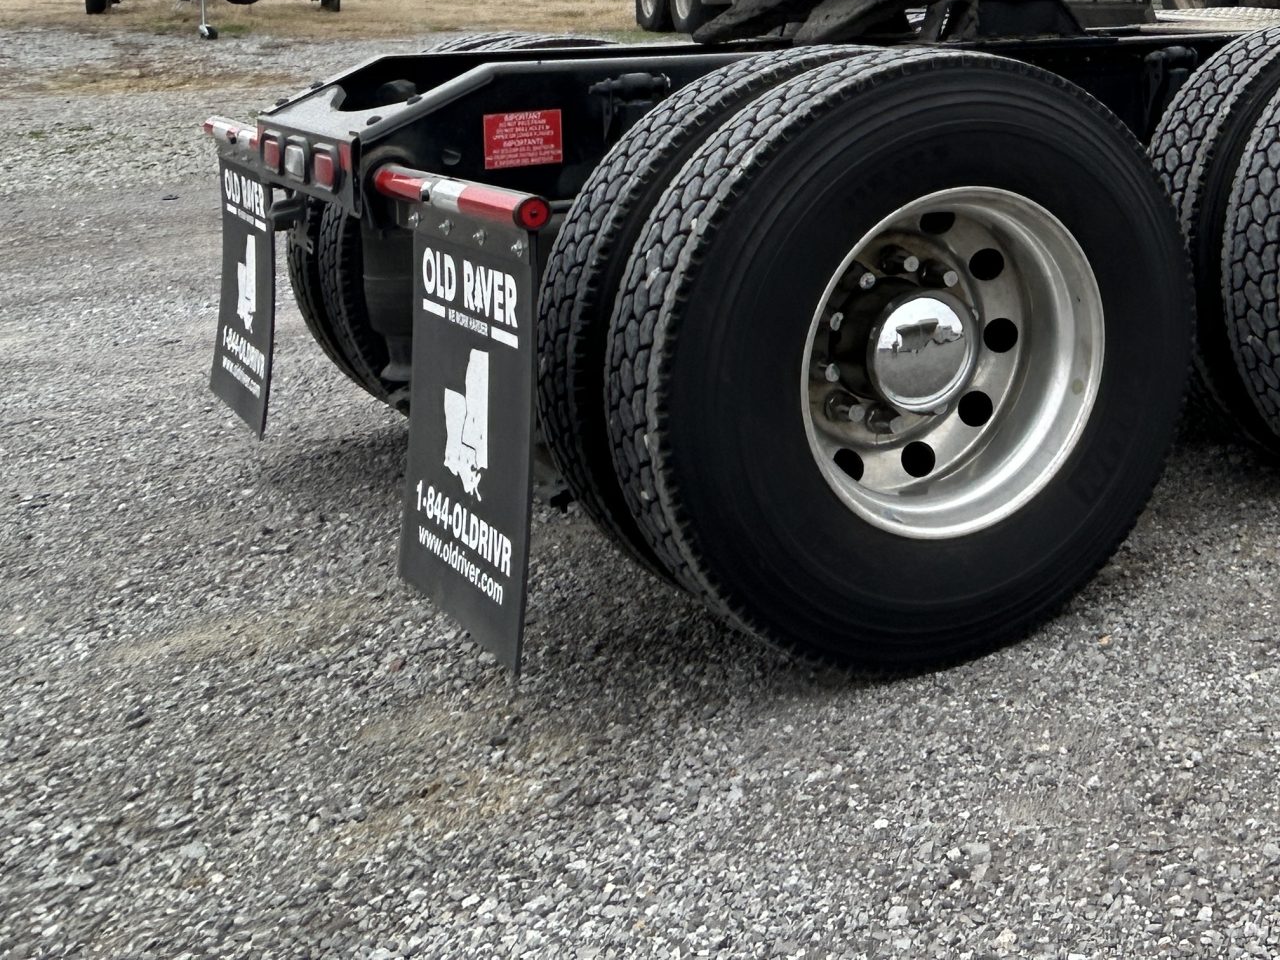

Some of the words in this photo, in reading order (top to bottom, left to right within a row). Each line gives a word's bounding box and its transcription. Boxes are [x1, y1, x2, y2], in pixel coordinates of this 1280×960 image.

[225, 168, 241, 204] OLD
[422, 247, 457, 302] OLD
[463, 259, 518, 329] RIVER
[416, 479, 512, 578] 1-844-OLDRIVR
[418, 525, 504, 606] www.oldriver.com
